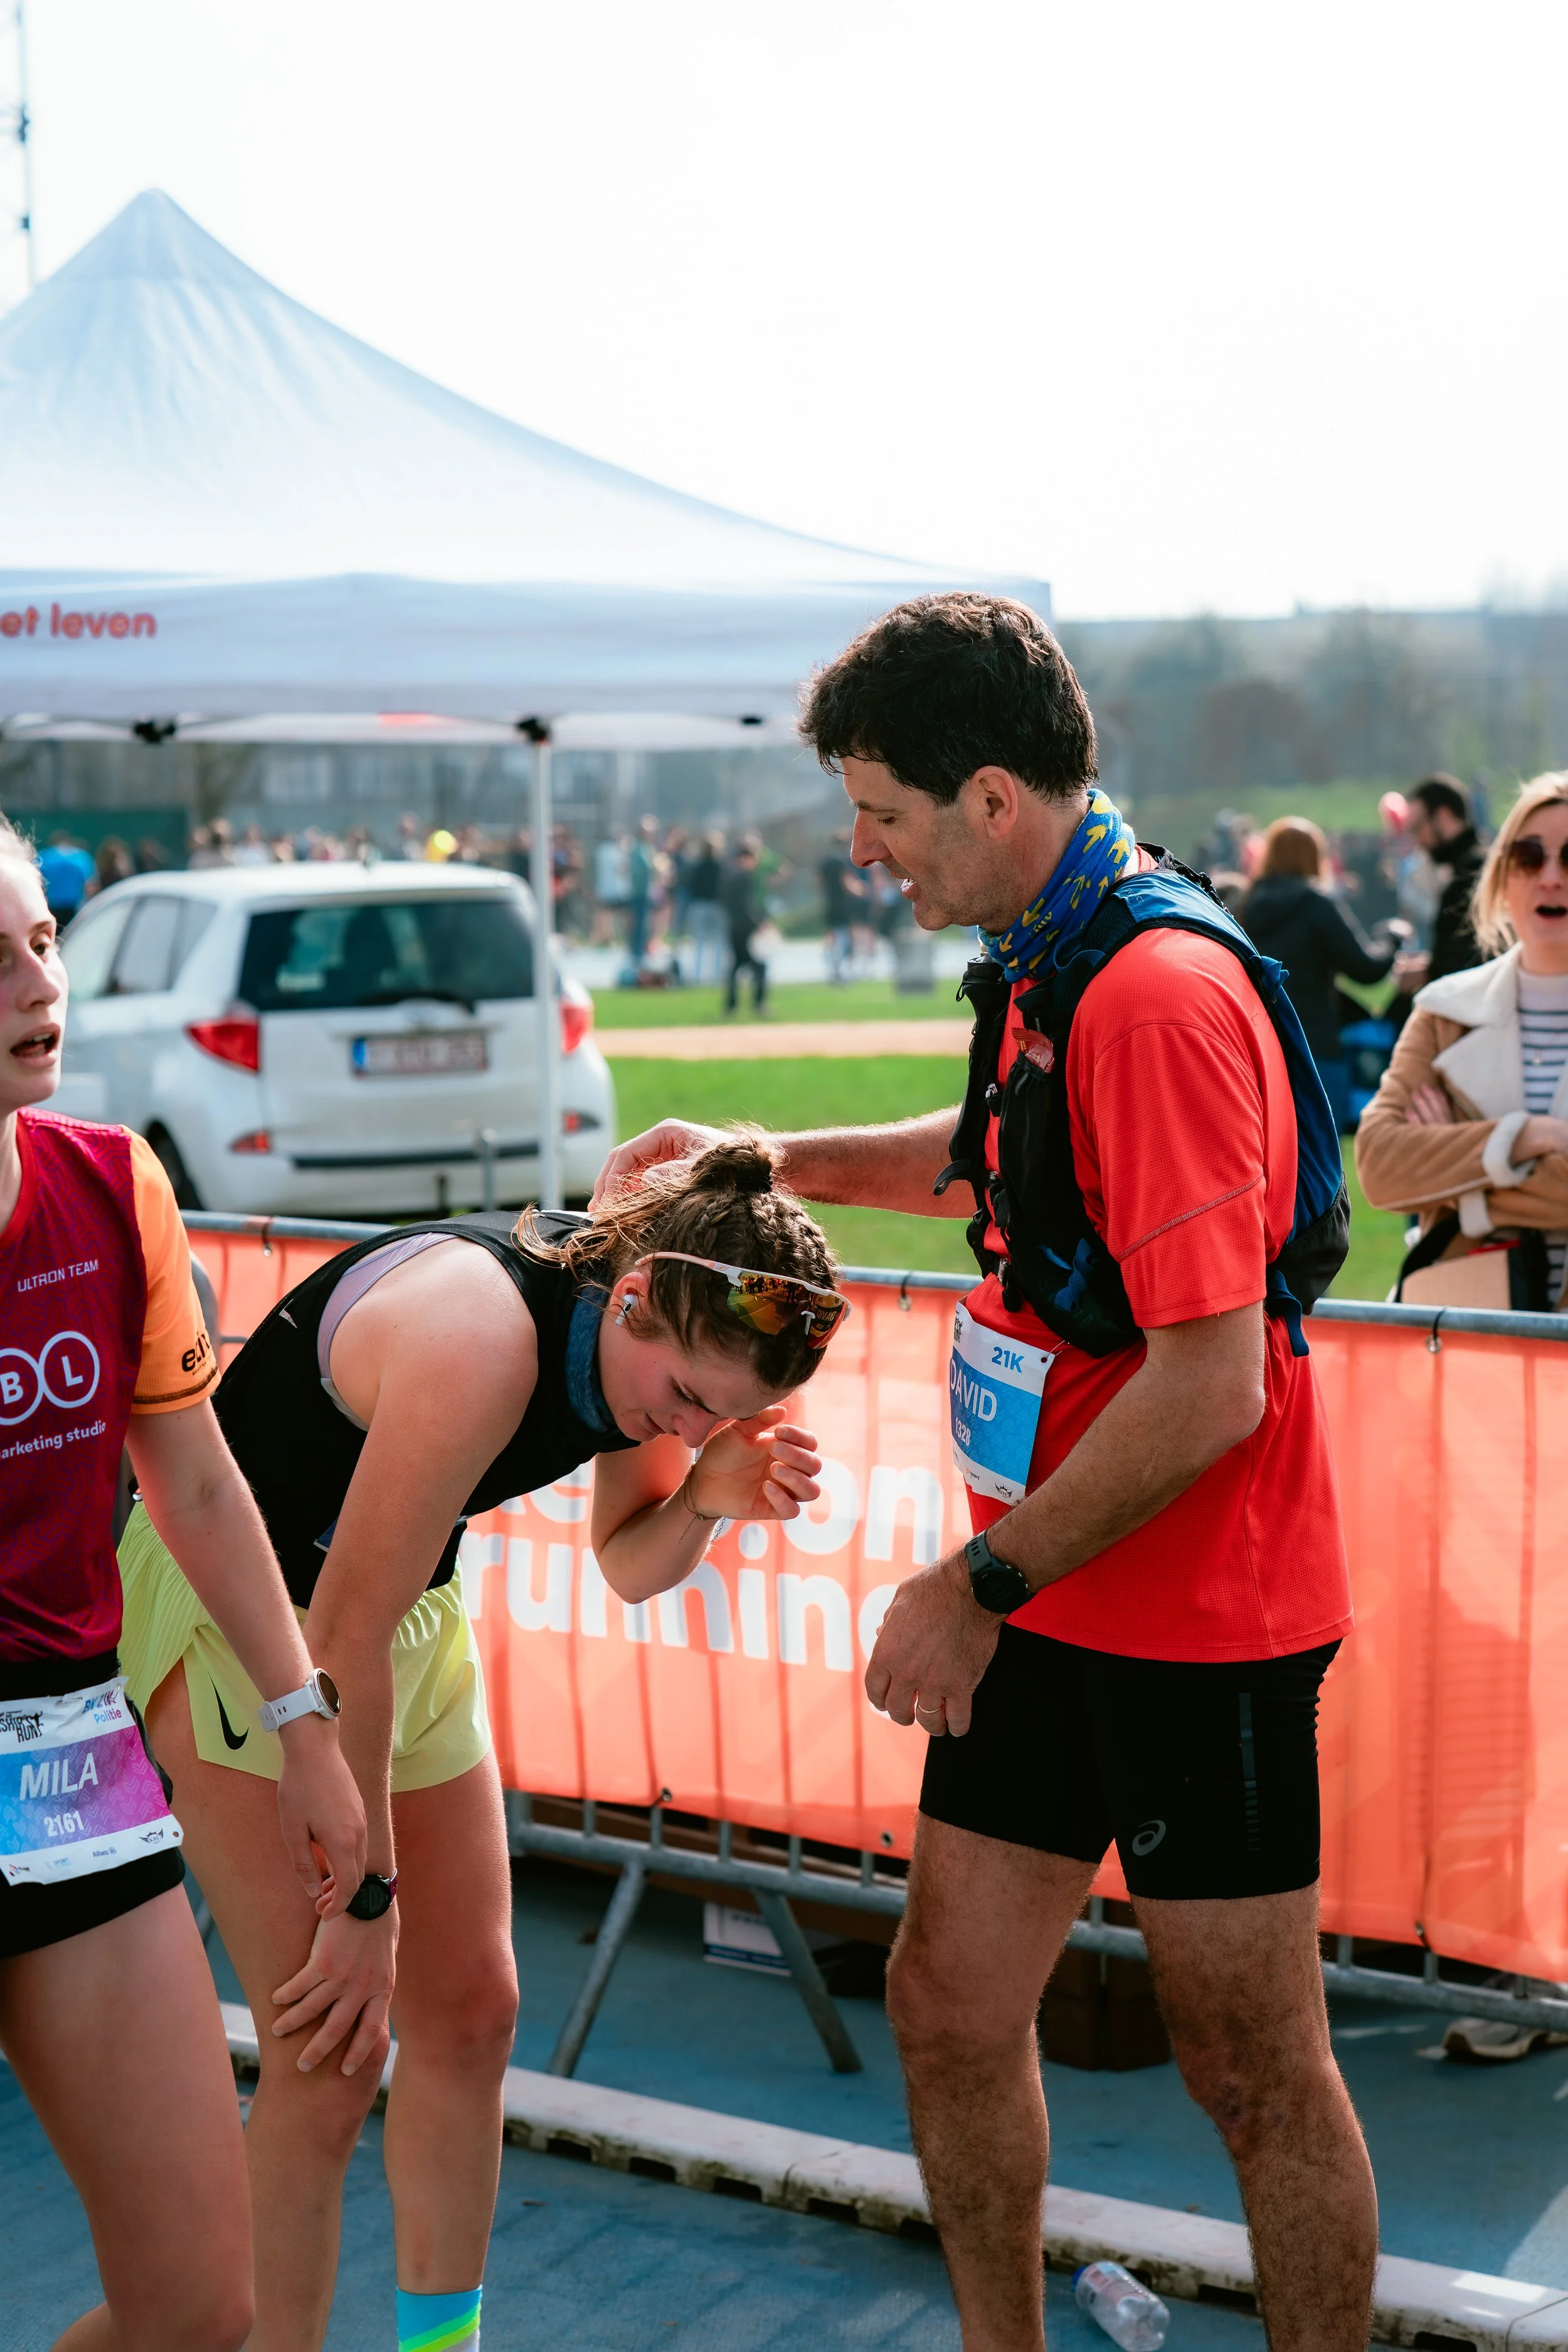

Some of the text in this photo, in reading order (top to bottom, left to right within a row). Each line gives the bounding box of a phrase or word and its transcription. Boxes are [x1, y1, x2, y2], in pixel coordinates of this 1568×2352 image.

[50, 602, 157, 639] leven
[18, 1259, 98, 1292] ULTRON TEAM
[61, 1356, 83, 1387] L
[992, 1347, 1024, 1374] 21K
[950, 1359, 997, 1421] DAVID
[0, 1419, 106, 1459] arketing studio
[955, 1417, 971, 1446] 1328
[93, 1708, 122, 1724] Politie
[19, 1752, 98, 1801] MILA
[44, 1811, 85, 1838] 2161
